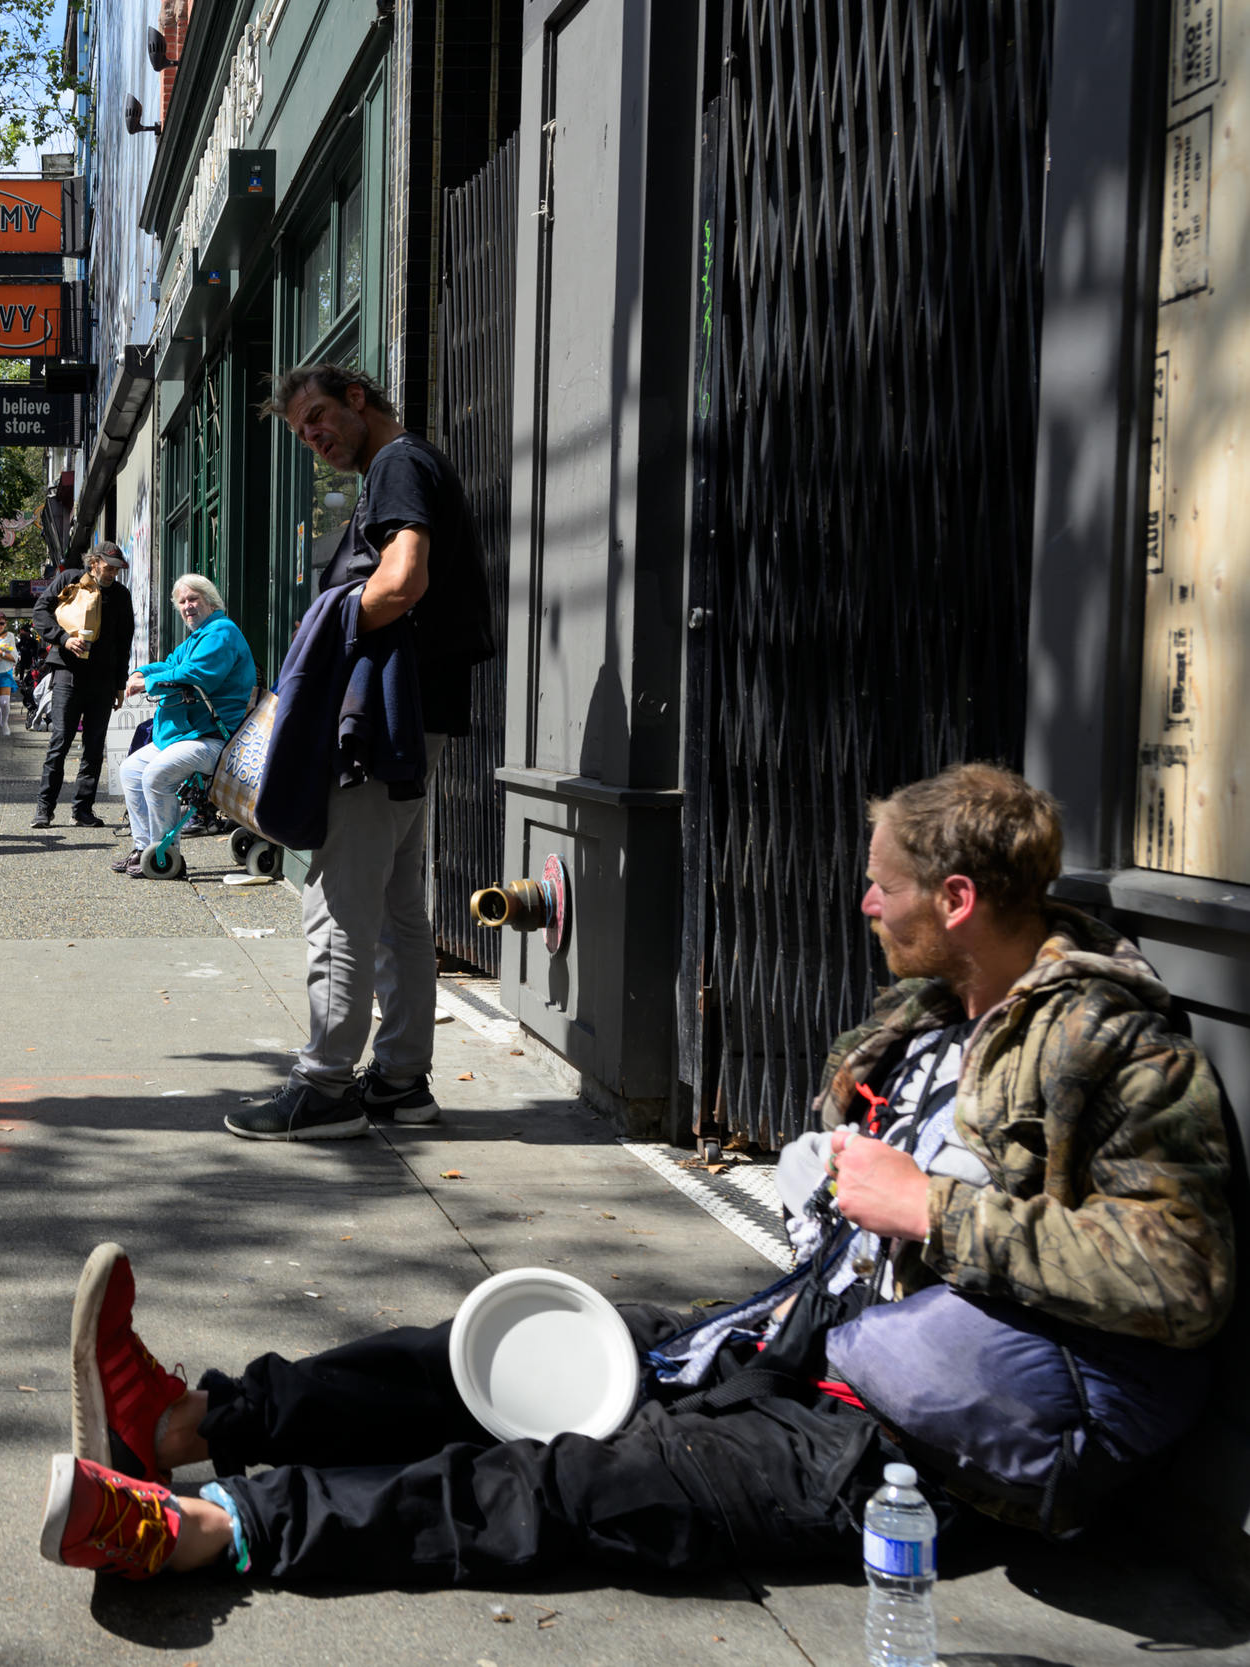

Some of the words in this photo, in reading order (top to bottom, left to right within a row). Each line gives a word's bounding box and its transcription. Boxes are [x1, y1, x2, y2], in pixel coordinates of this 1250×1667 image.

[1182, 135, 1193, 210] EXTERIOR
[2, 397, 51, 415] believe
[4, 418, 46, 434] store.
